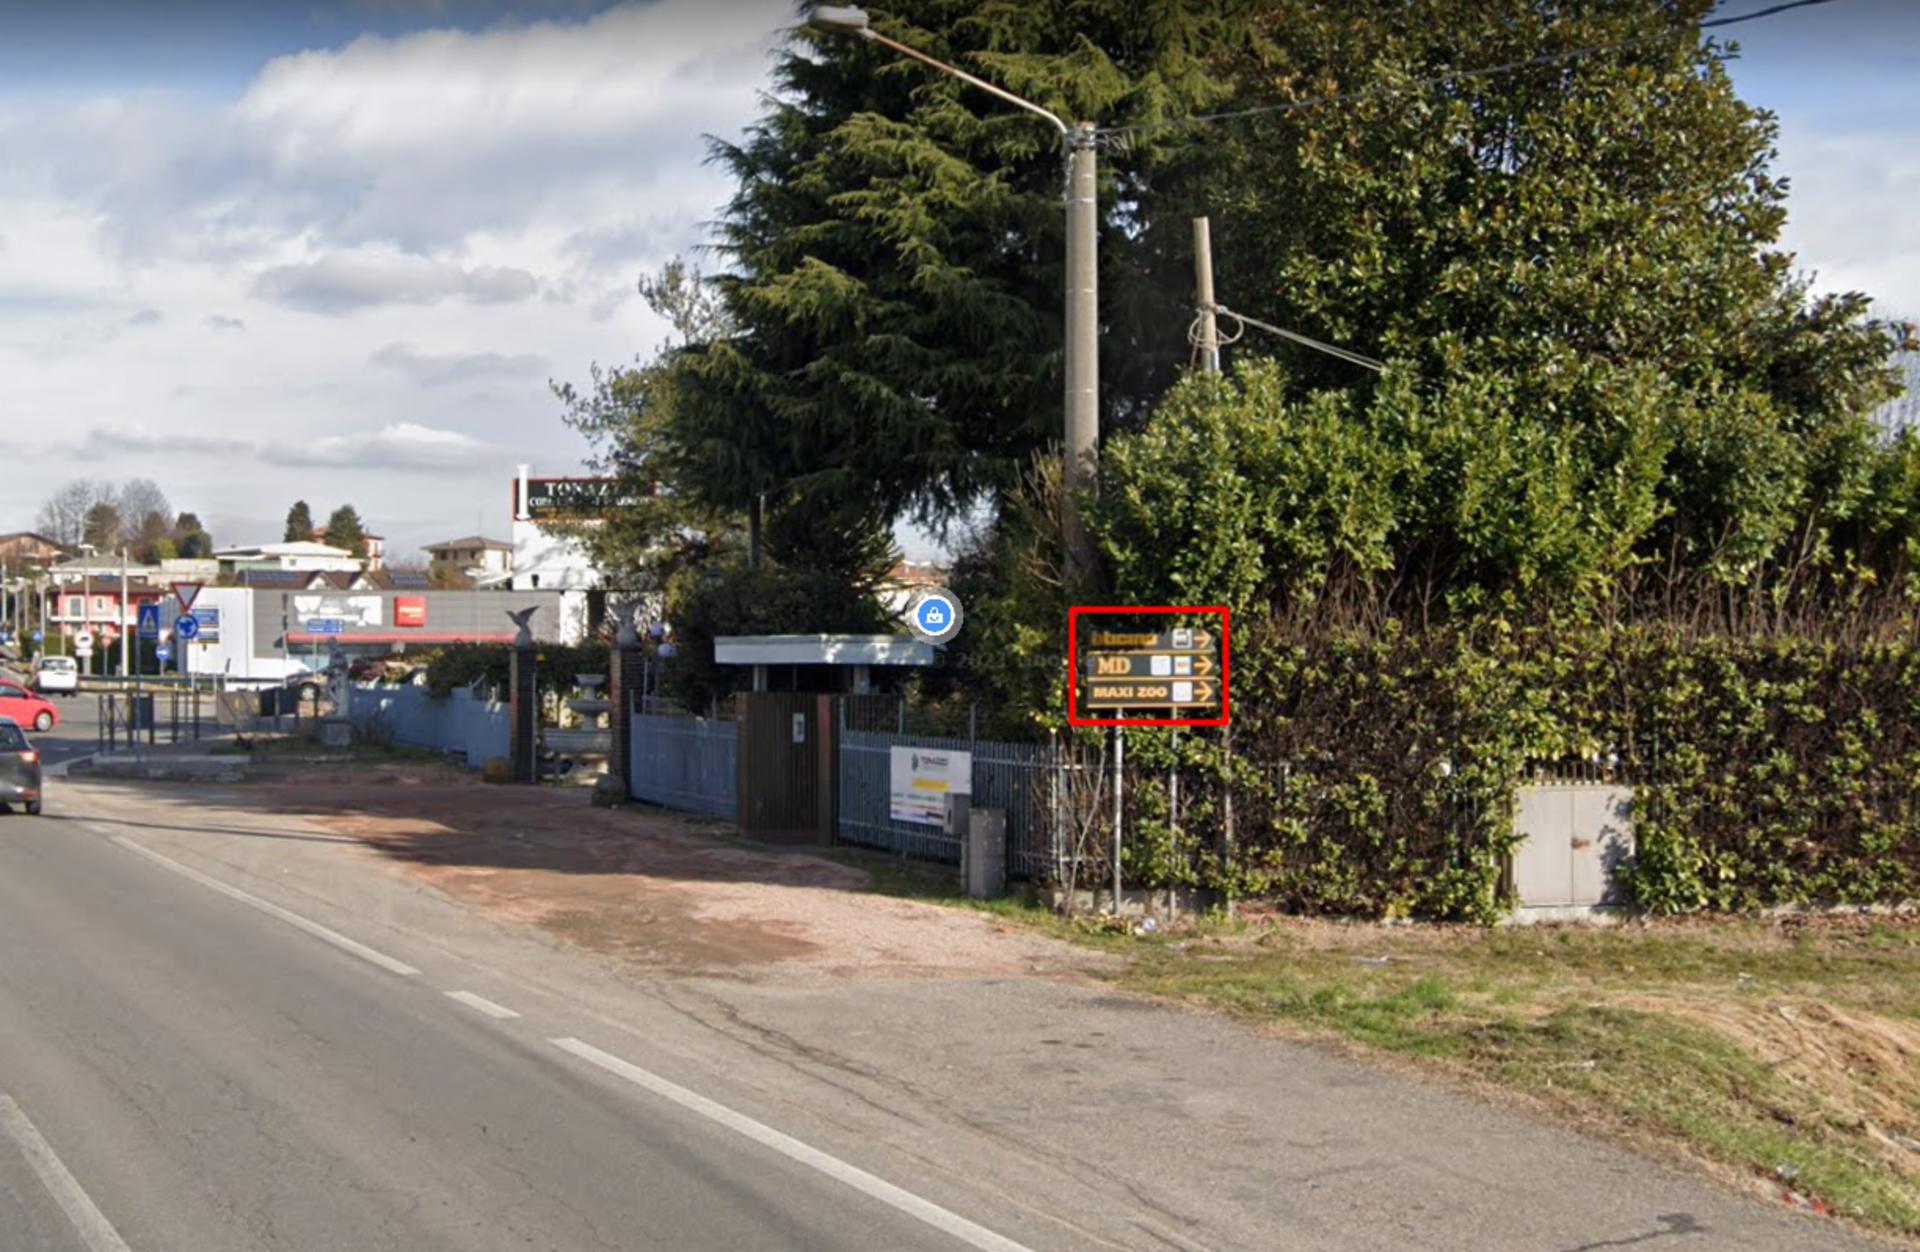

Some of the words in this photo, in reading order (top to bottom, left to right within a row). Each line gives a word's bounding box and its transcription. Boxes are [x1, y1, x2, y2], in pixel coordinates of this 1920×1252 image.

[1098, 656, 1131, 674] MD
[1093, 687, 1134, 698] MAXI
[1137, 687, 1169, 698] ZOO
